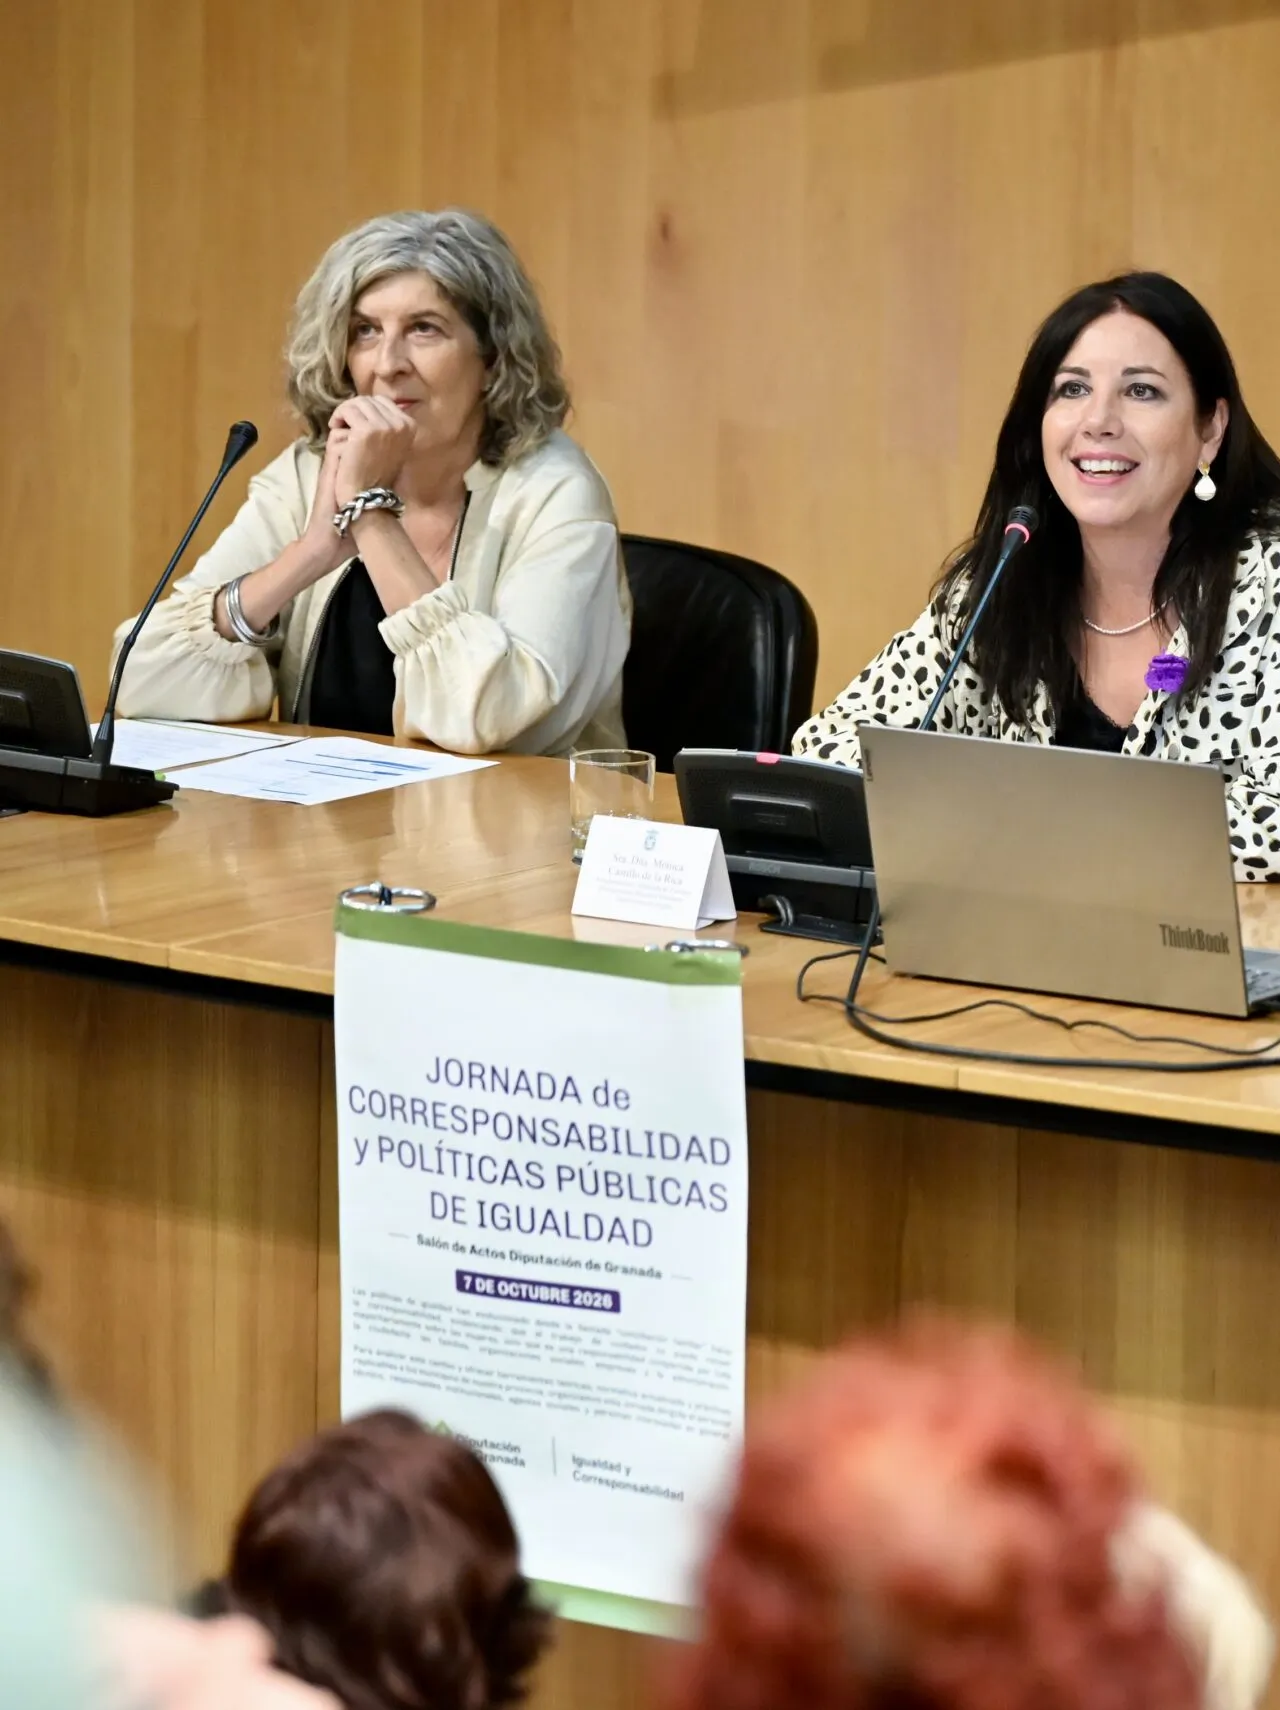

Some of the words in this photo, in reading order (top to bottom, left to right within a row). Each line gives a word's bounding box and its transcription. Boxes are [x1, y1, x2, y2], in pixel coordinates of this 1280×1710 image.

[1158, 923, 1230, 955] ThinkBook
[426, 1056, 582, 1104] JORNADA
[592, 1078, 631, 1111] de
[348, 1085, 732, 1167] CORRESPONSABILIDAD
[354, 1136, 369, 1166] y
[378, 1135, 546, 1191] POLÍTICAS
[556, 1161, 729, 1212] PÚBLICAS
[430, 1191, 467, 1225] DE
[477, 1200, 654, 1248] IGUALDAD
[416, 1233, 450, 1251] Salón
[452, 1240, 467, 1254] de
[469, 1243, 507, 1260] Actos
[509, 1248, 582, 1271] Diputación
[585, 1258, 602, 1273] de
[604, 1261, 663, 1281] Granada
[462, 1274, 473, 1291] 7
[475, 1277, 495, 1296] DE
[497, 1280, 571, 1304] OCTUBRE
[571, 1453, 622, 1475] Igualdad
[624, 1464, 633, 1477] y
[572, 1469, 685, 1502] Corresponsabilidad
